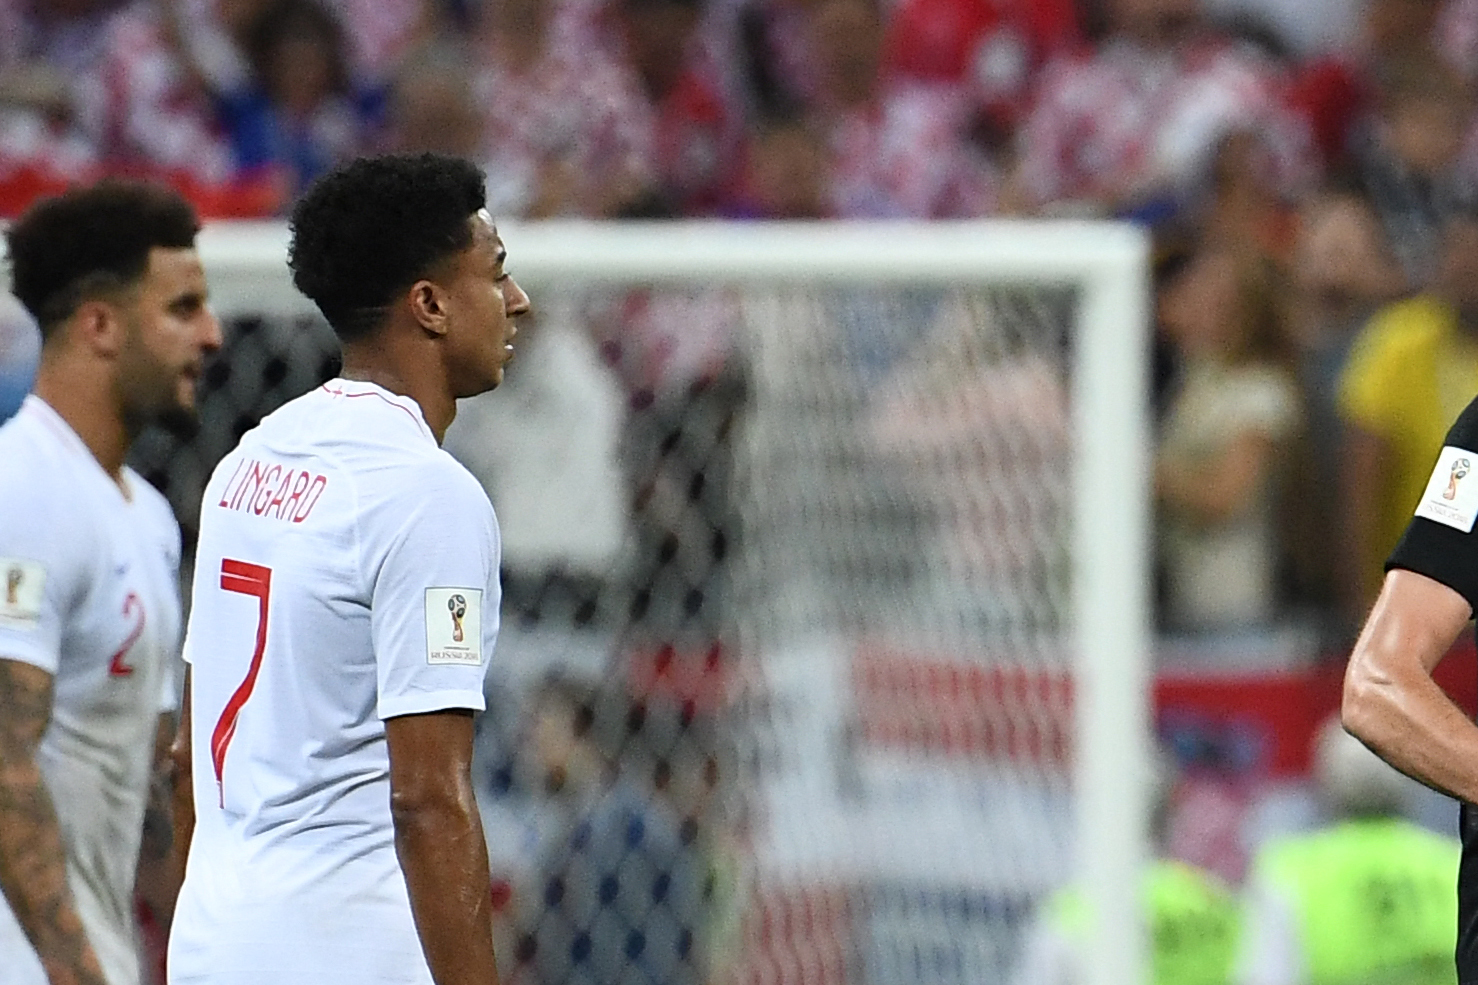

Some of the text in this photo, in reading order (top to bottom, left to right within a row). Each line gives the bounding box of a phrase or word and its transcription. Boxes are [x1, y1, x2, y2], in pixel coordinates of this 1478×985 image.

[218, 457, 327, 523] LINGARD
[107, 592, 146, 677] 2
[210, 558, 273, 809] 7
